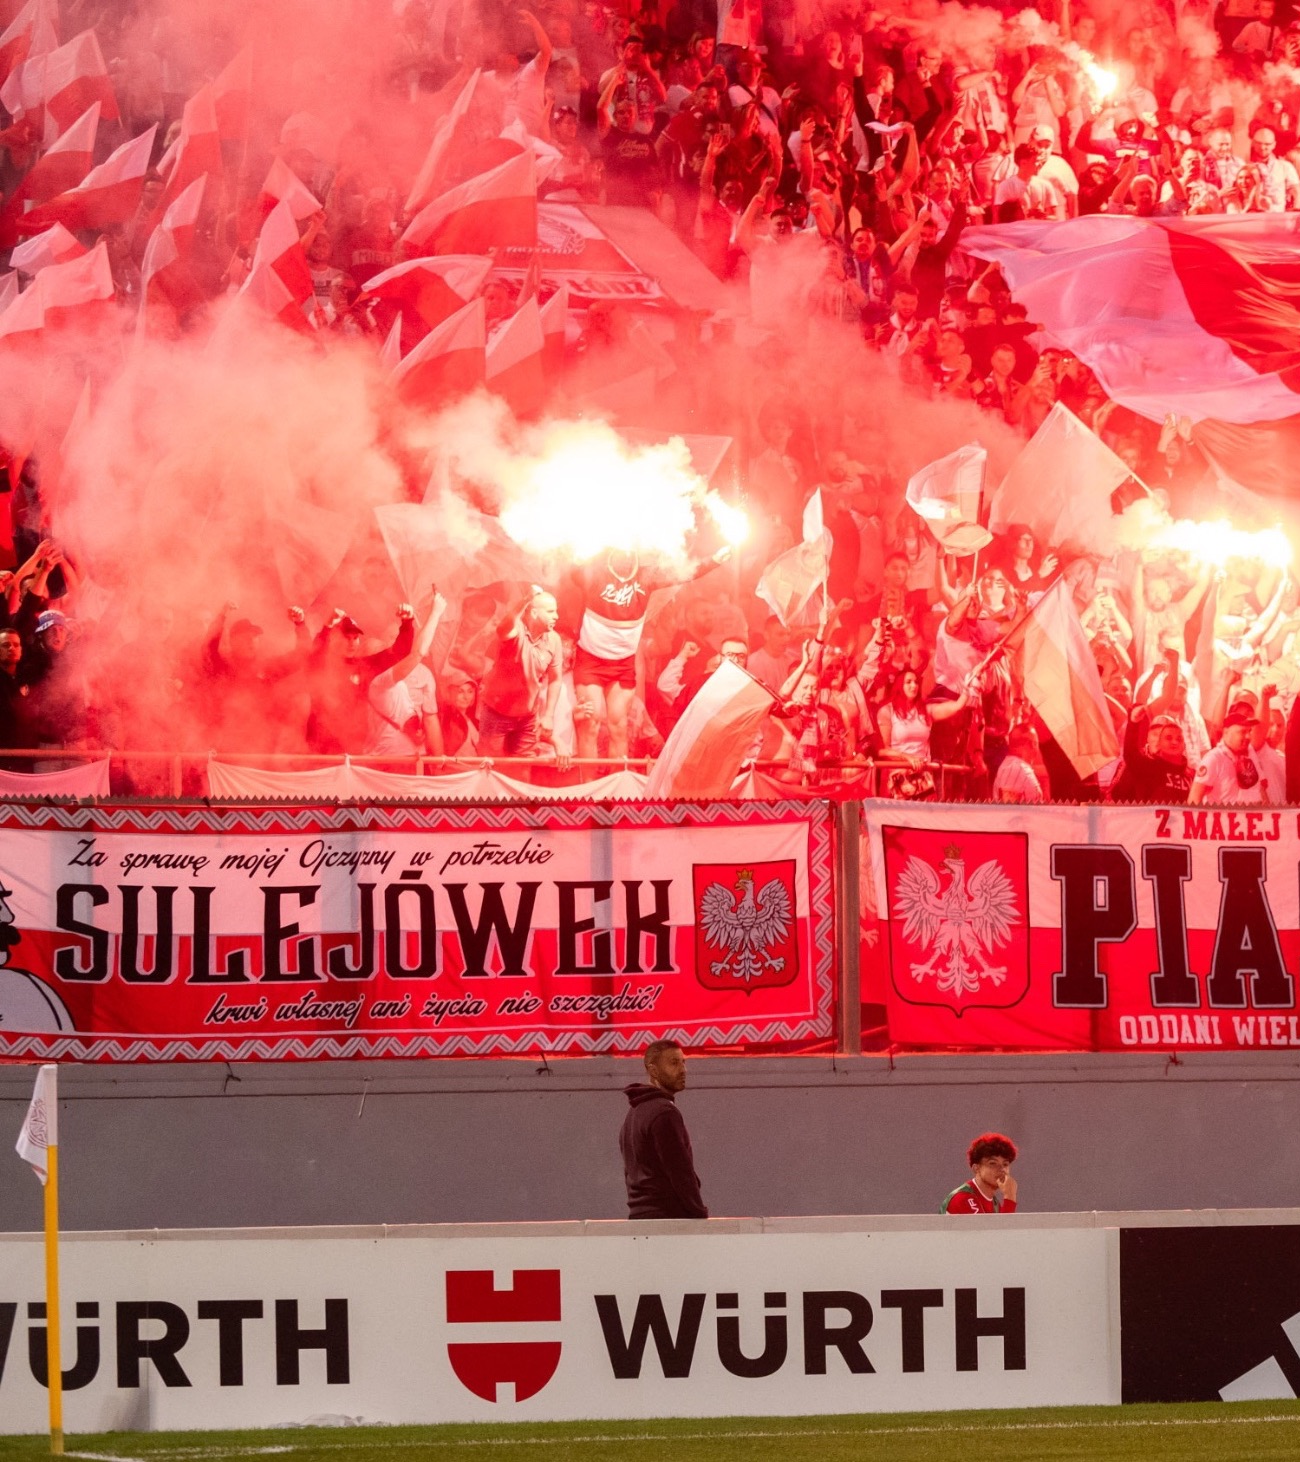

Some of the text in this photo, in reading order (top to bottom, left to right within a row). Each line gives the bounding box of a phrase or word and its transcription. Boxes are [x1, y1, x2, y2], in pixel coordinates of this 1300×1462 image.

[1155, 810, 1170, 838] Z
[1182, 811, 1281, 841] MAŁEJ
[68, 837, 554, 878] Za sprawę mojej Ojczyzny w potrzebie
[54, 870, 680, 985] SULEJÓWEK
[203, 982, 663, 1028] krwi własnej ani życia nie szczędzić!
[1119, 1015, 1223, 1045] ODDANI
[594, 1286, 1027, 1380] WÜRTH
